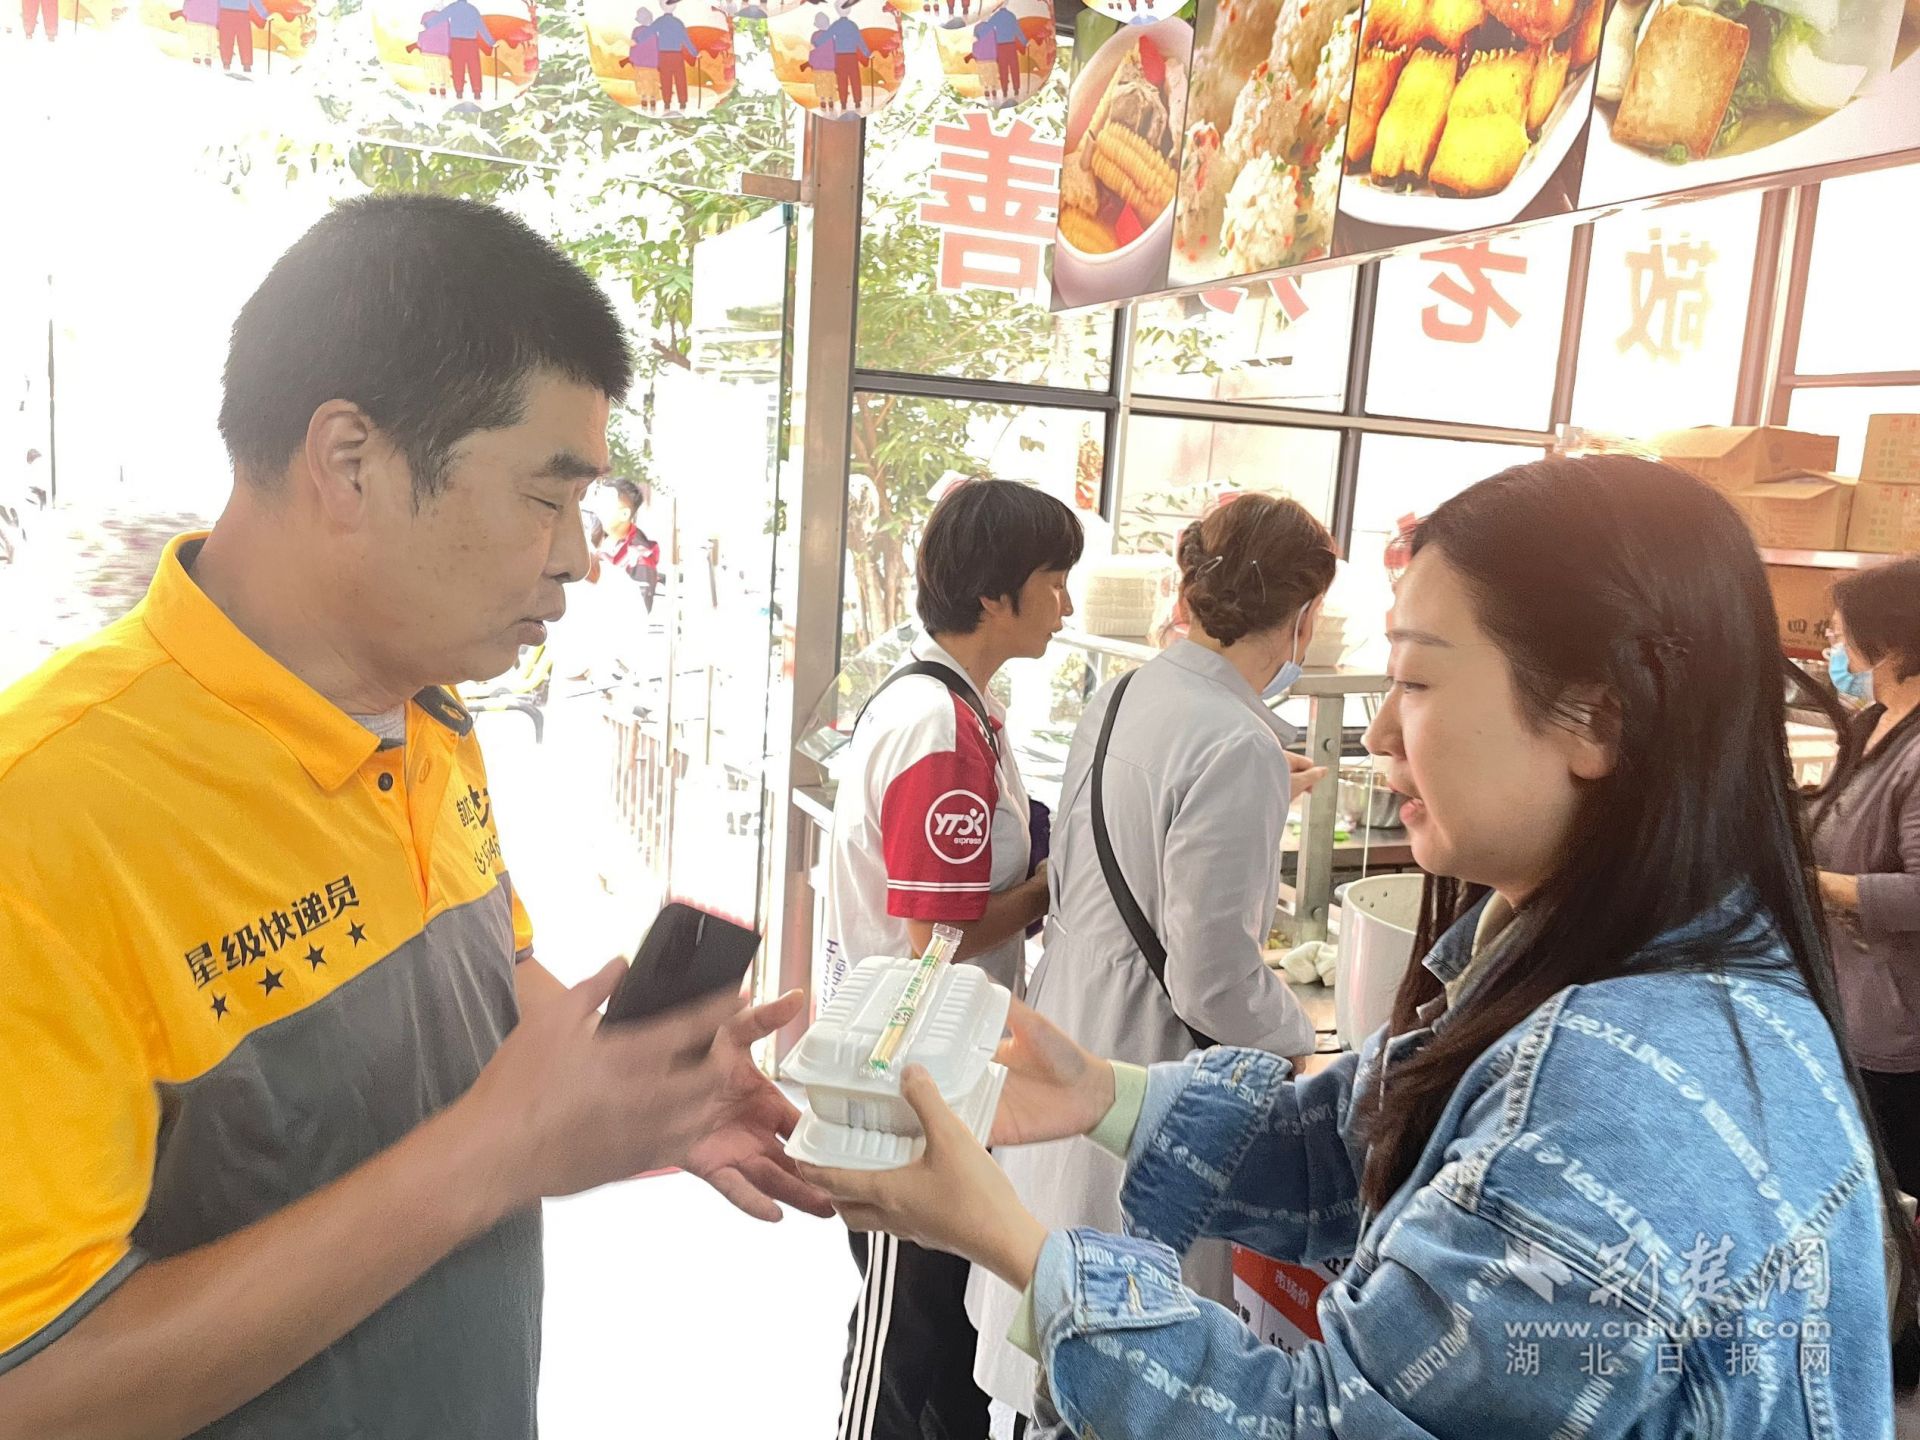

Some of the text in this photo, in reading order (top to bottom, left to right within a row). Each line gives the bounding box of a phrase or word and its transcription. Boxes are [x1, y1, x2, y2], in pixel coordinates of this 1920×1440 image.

[185, 874, 360, 989] 星级快递员
